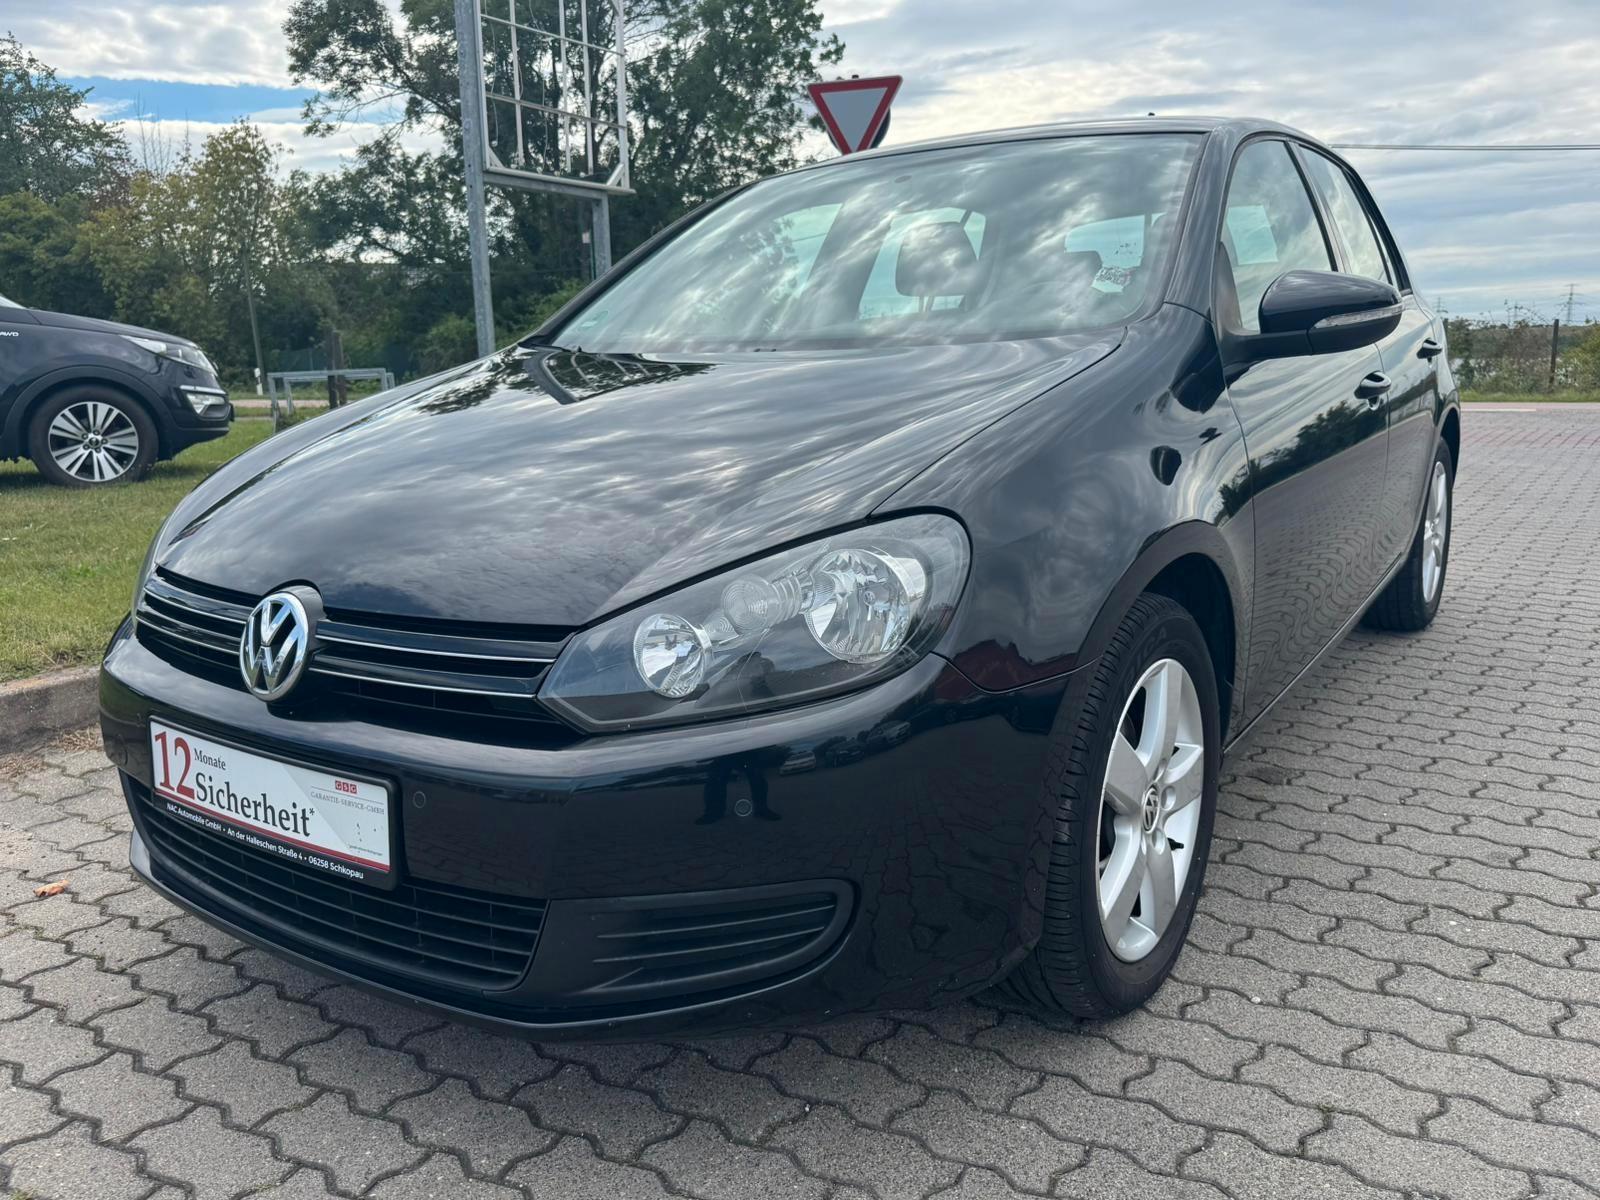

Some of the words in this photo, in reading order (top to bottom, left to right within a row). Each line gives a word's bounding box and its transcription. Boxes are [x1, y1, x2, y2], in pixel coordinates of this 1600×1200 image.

[154, 731, 195, 800] 12
[194, 748, 226, 770] Monate
[178, 807, 205, 825] Automobile
[205, 819, 222, 832] GmbH
[227, 828, 235, 837] An
[236, 831, 245, 840] der
[246, 834, 277, 852] Halleschen
[278, 845, 298, 859] Straße
[298, 853, 303, 861] 4
[308, 856, 329, 869] 06258
[330, 862, 364, 879] Schkopau
